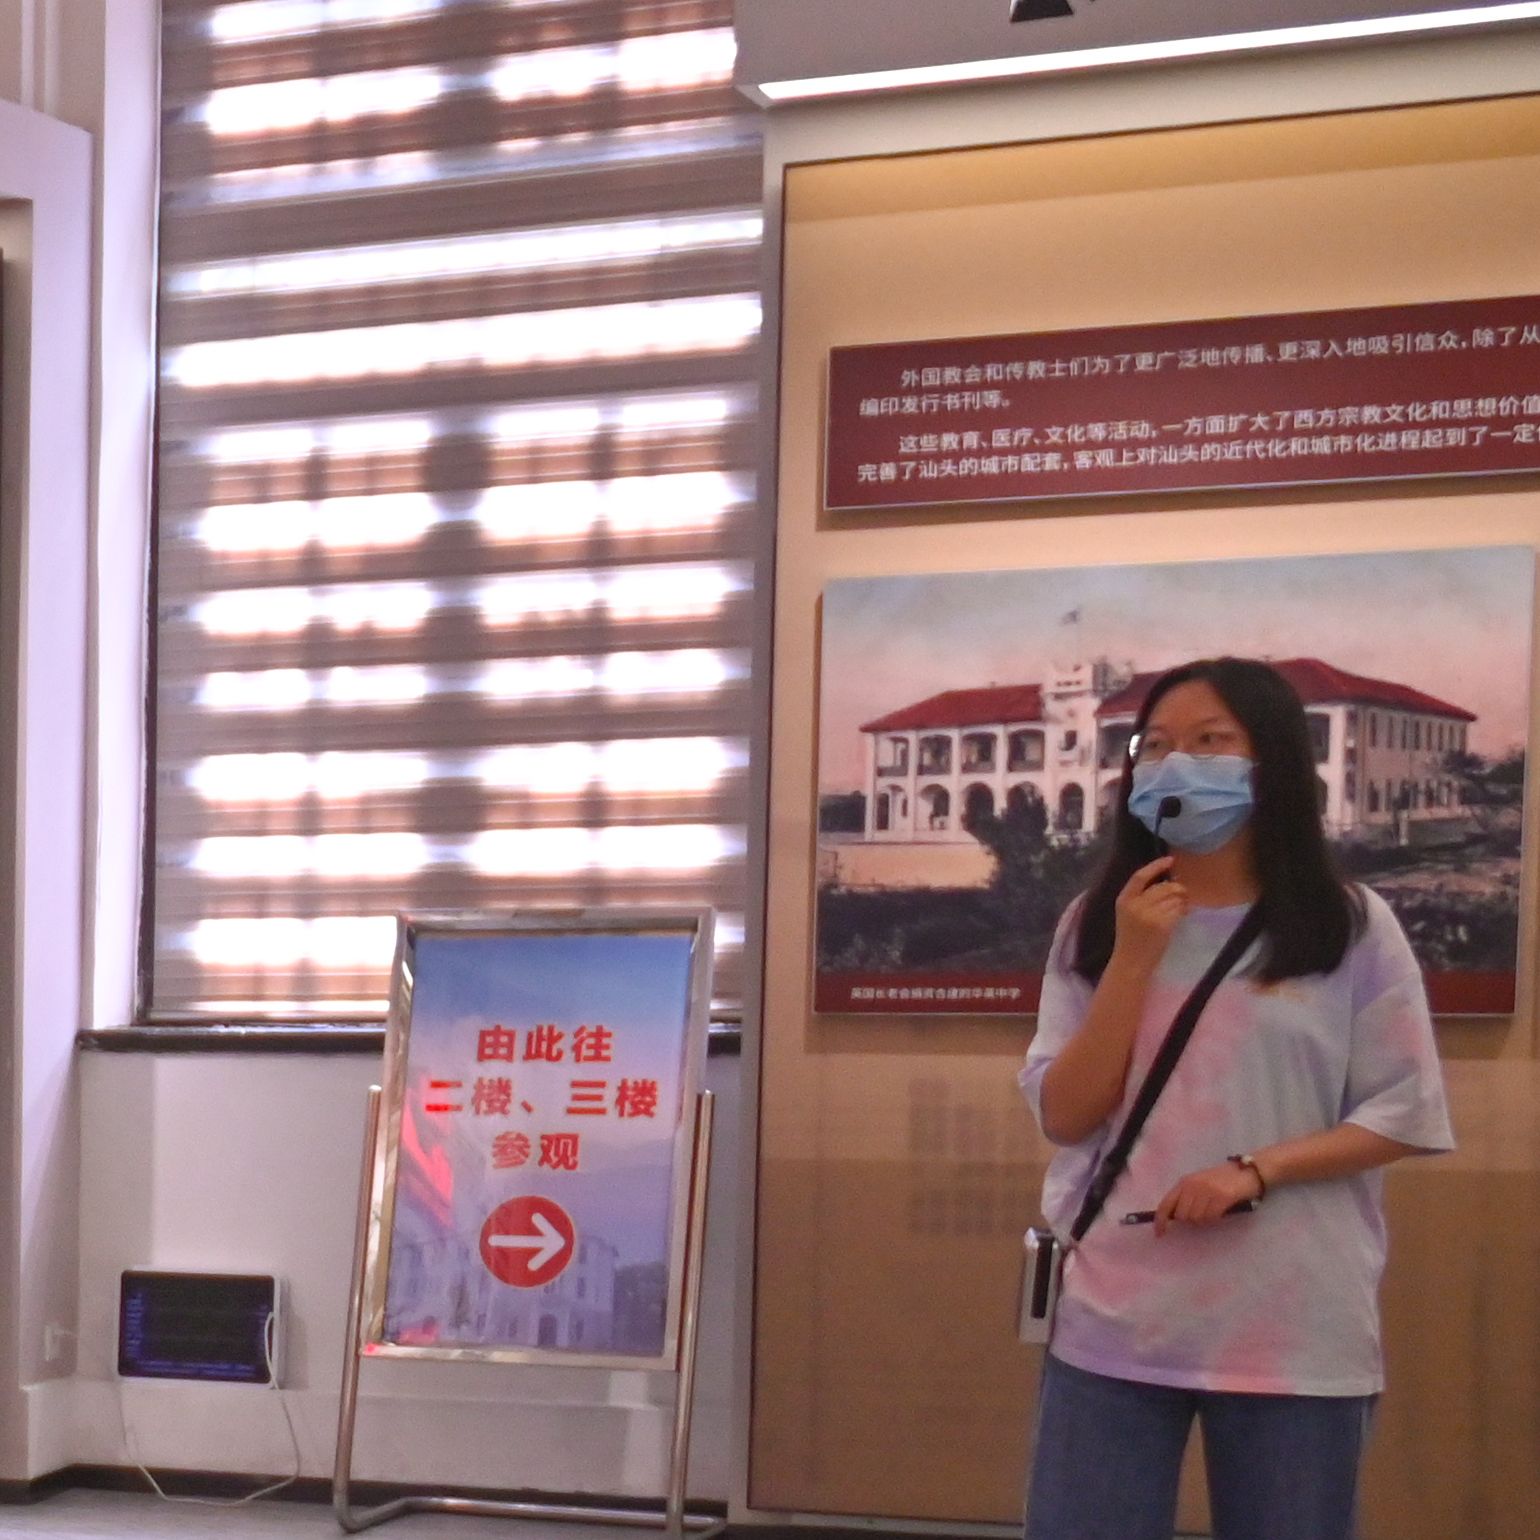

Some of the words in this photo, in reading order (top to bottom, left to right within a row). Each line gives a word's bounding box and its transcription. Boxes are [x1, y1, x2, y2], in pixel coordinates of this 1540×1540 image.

[857, 423, 1540, 482] 完善了汕头的城市配套,客观上对汕头的近代化和城市化进程起到了一定
[476, 1025, 612, 1063] 由此往
[425, 1077, 658, 1118] 二楼、三楼
[491, 1131, 580, 1170] 参观
